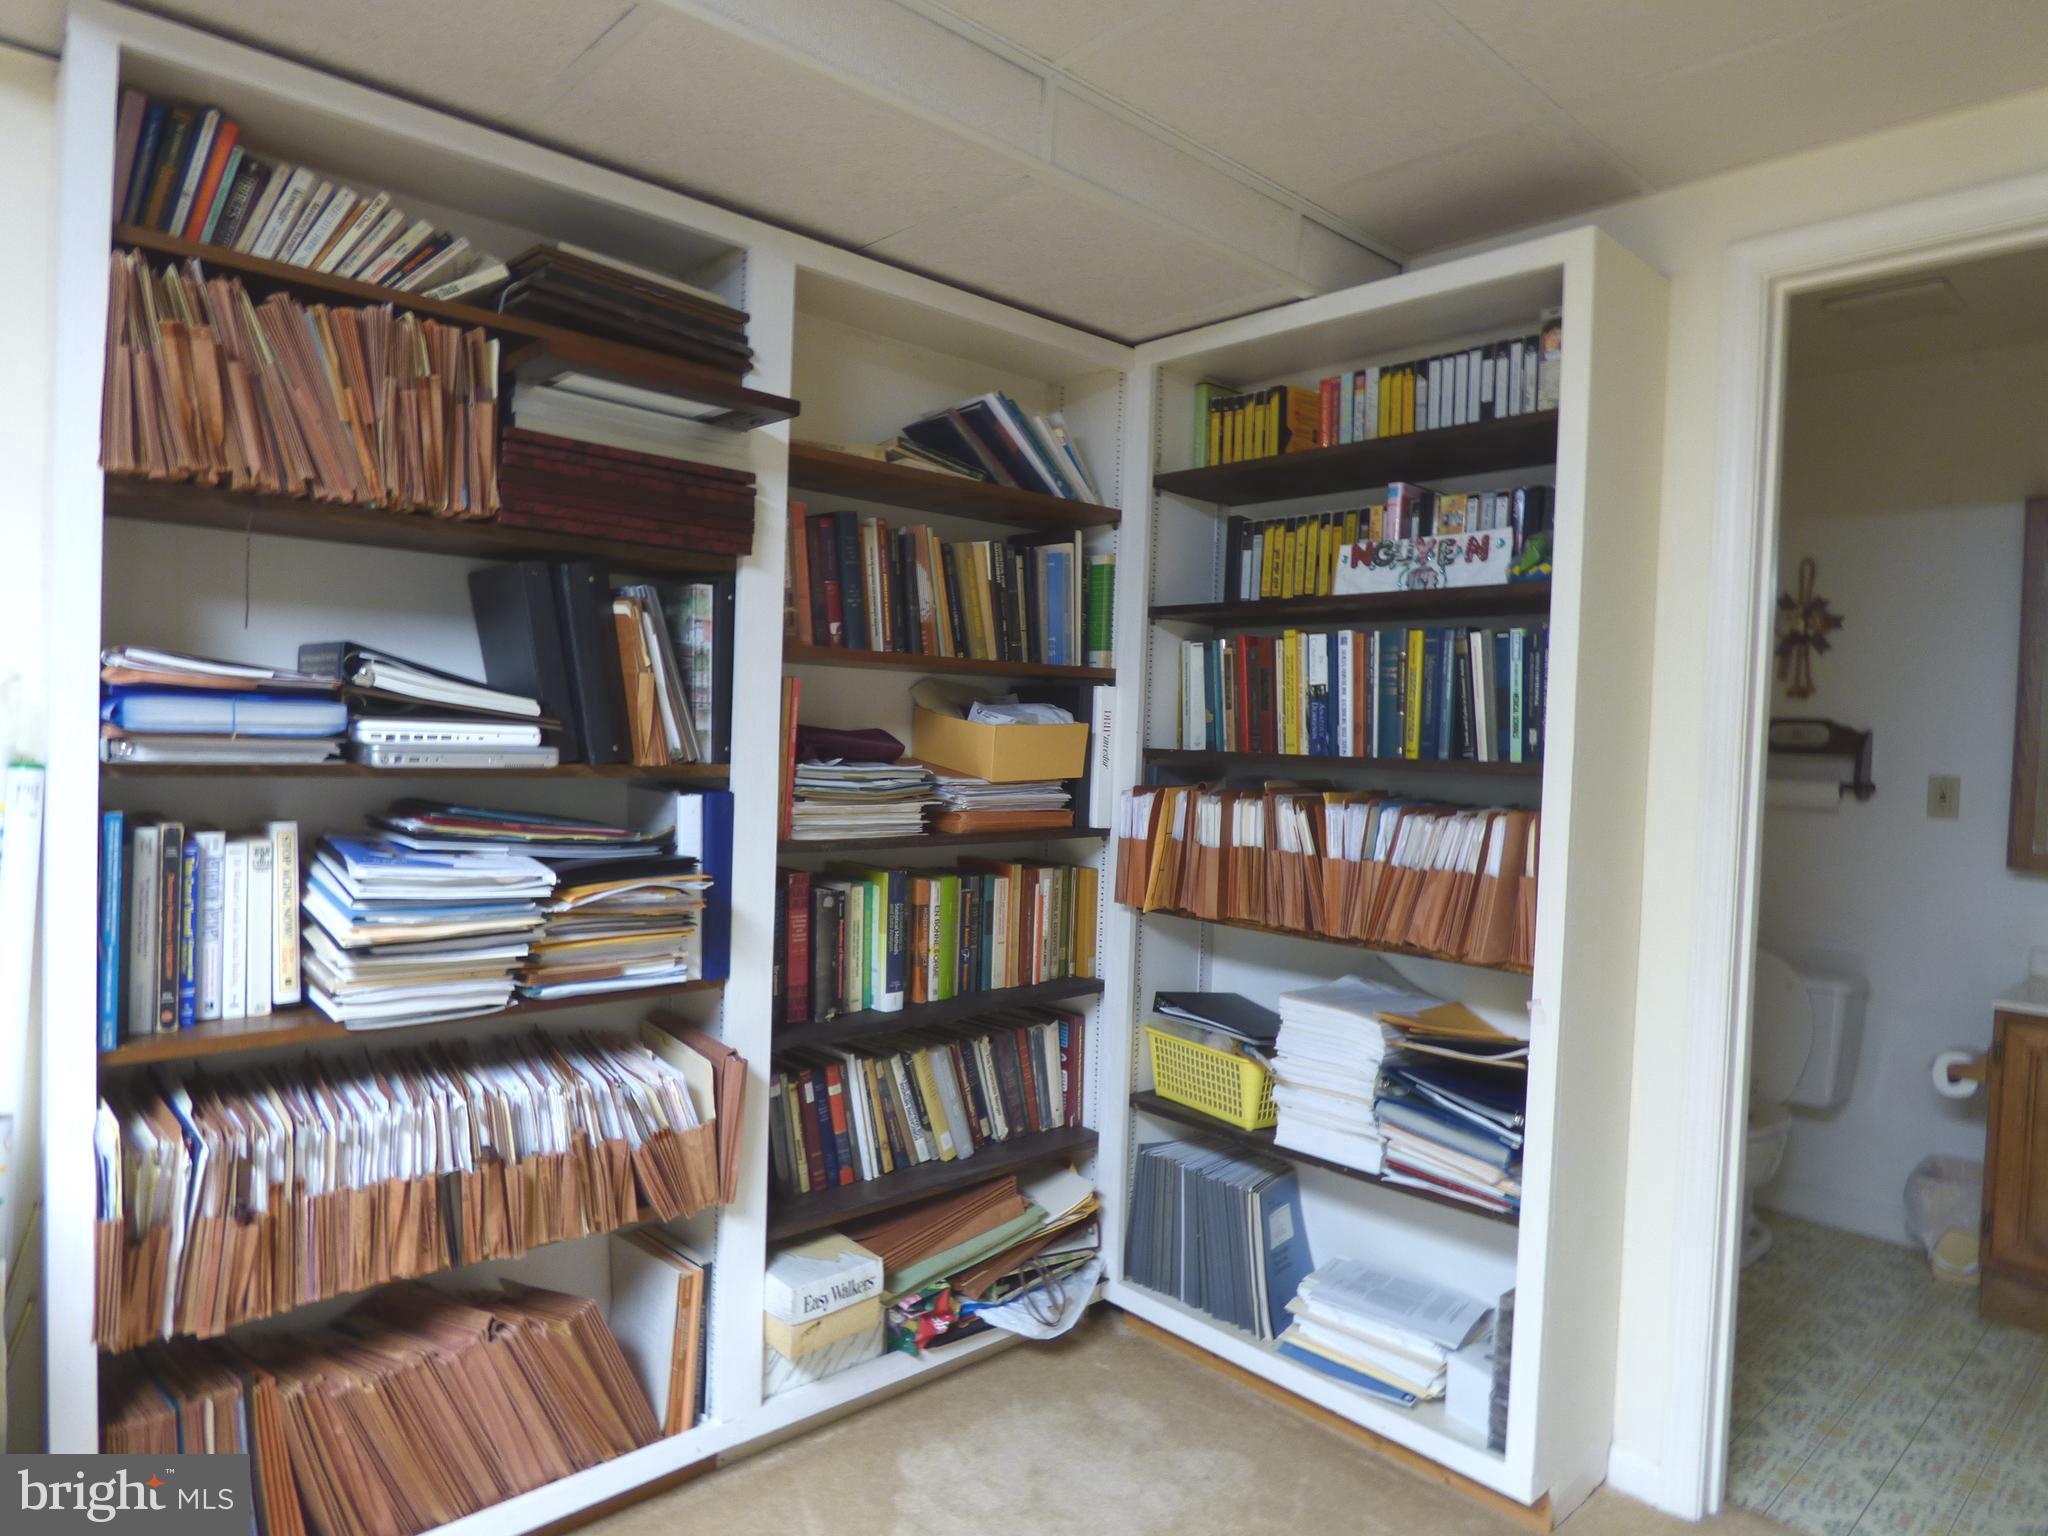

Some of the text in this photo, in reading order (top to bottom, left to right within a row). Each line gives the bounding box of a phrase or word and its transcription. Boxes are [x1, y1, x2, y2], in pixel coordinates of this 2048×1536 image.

[1350, 534, 1490, 568] NGUYEN
[803, 1275, 877, 1314] Easy Walkers
